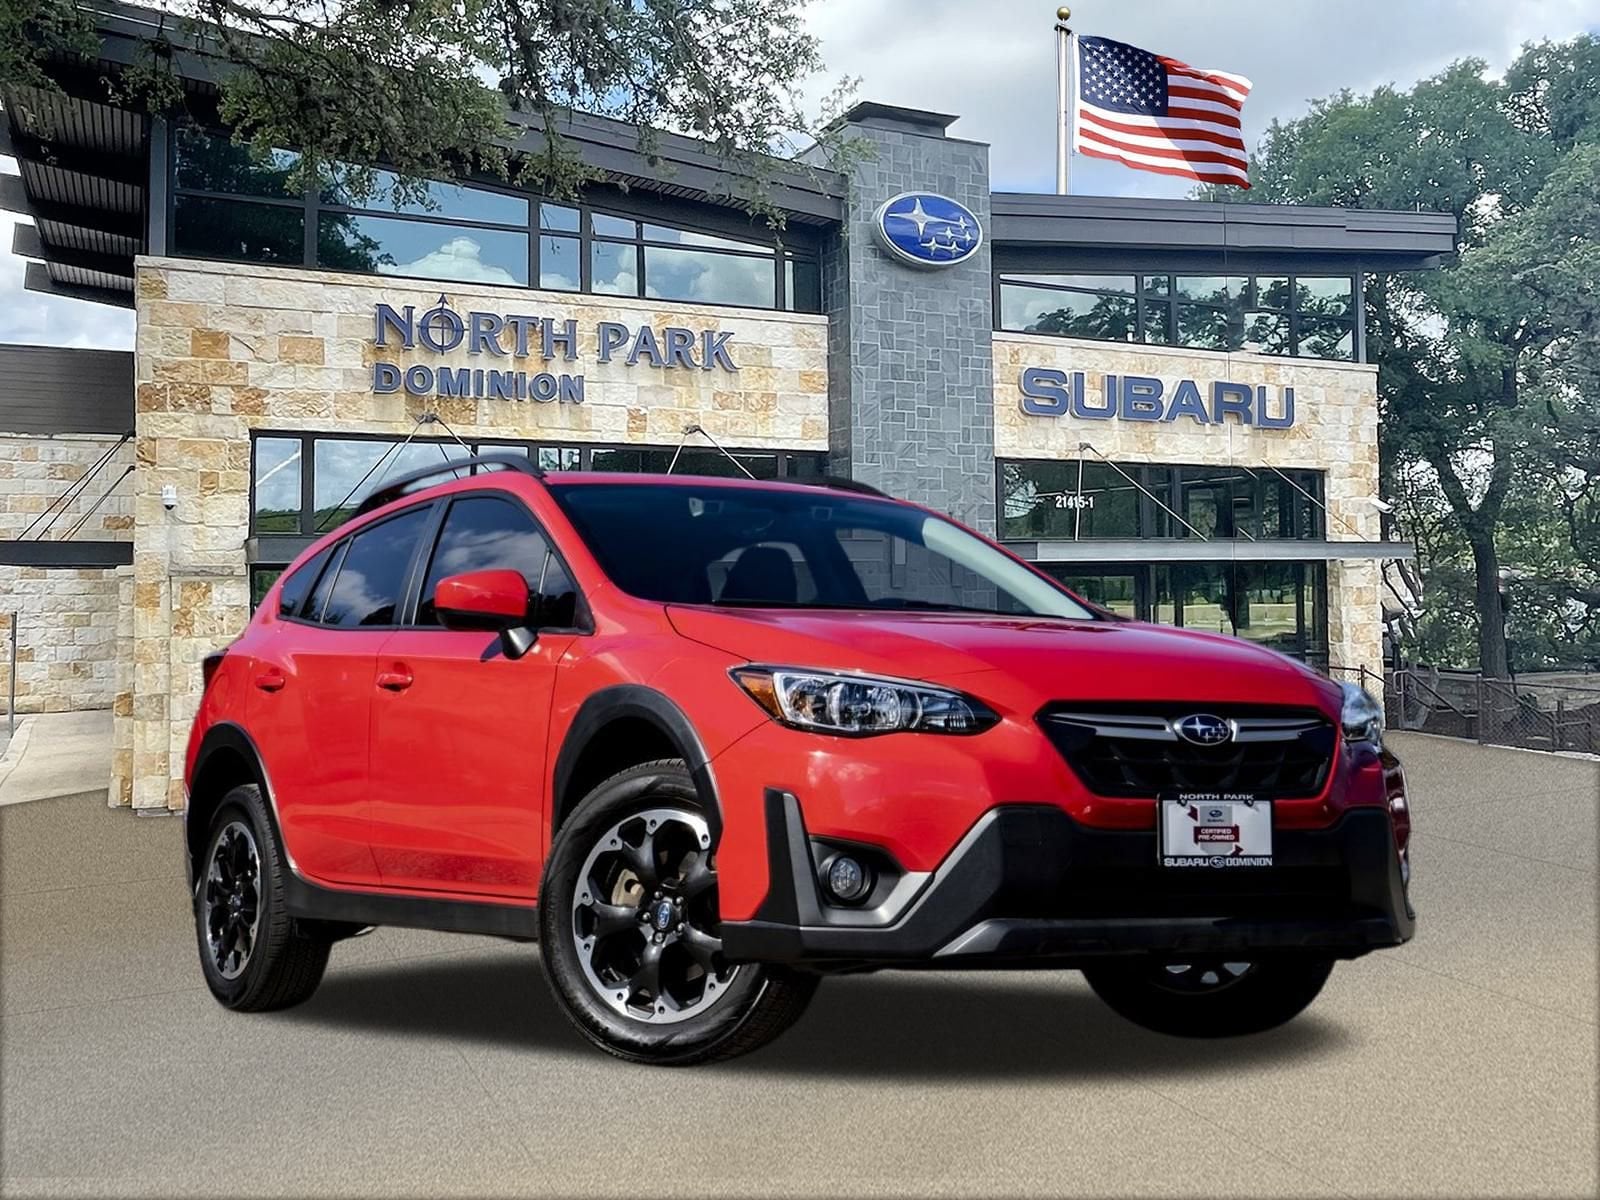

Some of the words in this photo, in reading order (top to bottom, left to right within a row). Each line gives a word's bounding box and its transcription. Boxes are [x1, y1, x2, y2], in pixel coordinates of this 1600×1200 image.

[373, 293, 580, 361] NORTH
[597, 320, 742, 373] PARK
[372, 361, 585, 404] DOMINION
[1018, 366, 1295, 430] SUBARU
[1055, 495, 1094, 509] 21415-1
[1164, 858, 1209, 867] SUBARU
[1226, 857, 1273, 867] DOMINION
